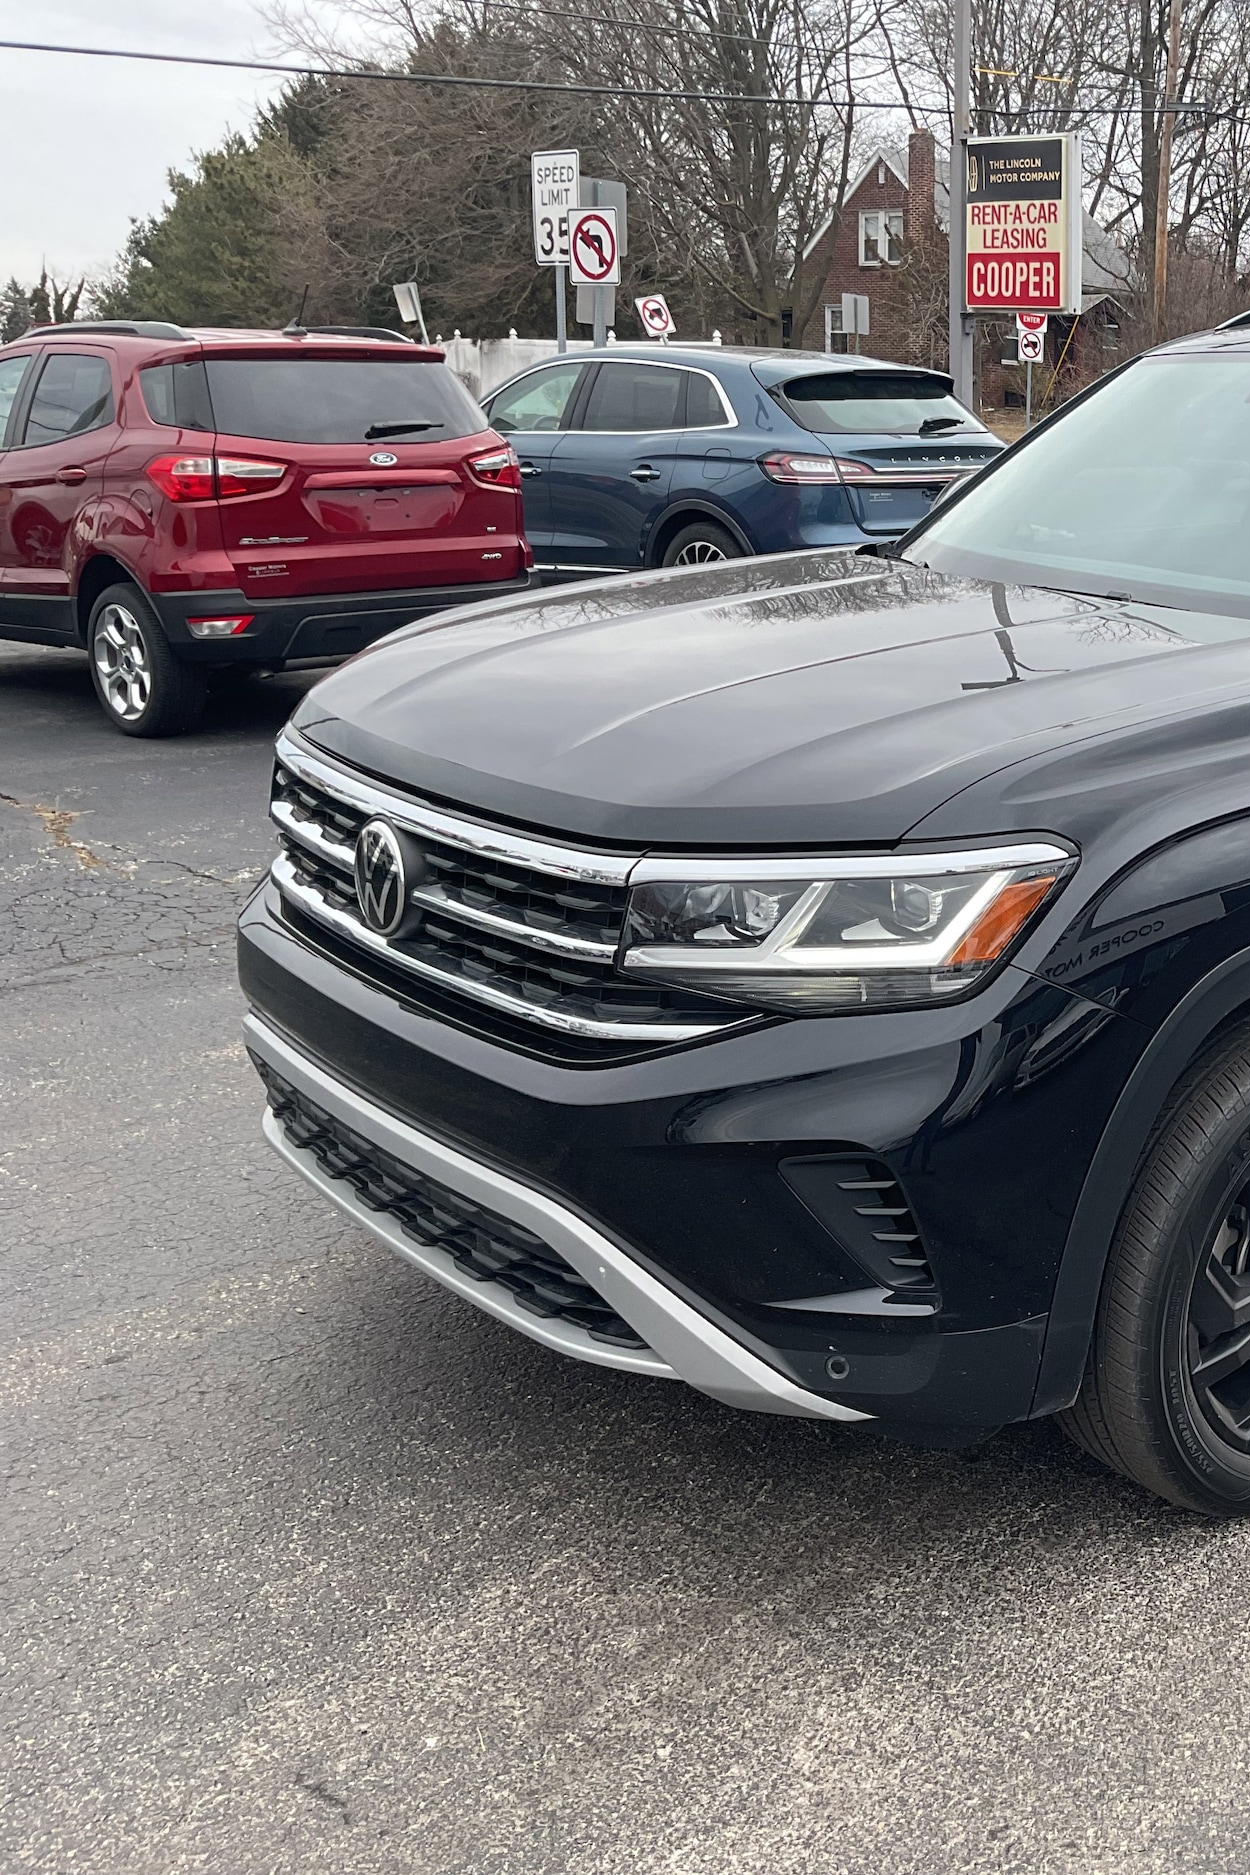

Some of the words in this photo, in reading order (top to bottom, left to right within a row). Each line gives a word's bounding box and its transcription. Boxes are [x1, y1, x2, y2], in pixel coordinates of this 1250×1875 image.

[989, 160, 1005, 169] THE
[1005, 158, 1042, 169] LINCOLN
[536, 165, 575, 184] SPEED
[989, 173, 1018, 183] MOTOR
[1019, 171, 1061, 182] COMPANY
[540, 188, 571, 206] LIMIT
[971, 202, 1058, 225] RENT-A-CAR
[983, 227, 1047, 249] LEASING
[972, 261, 1055, 297] COOPER
[1023, 315, 1041, 324] ENTER
[891, 454, 986, 464] LINCOLN
